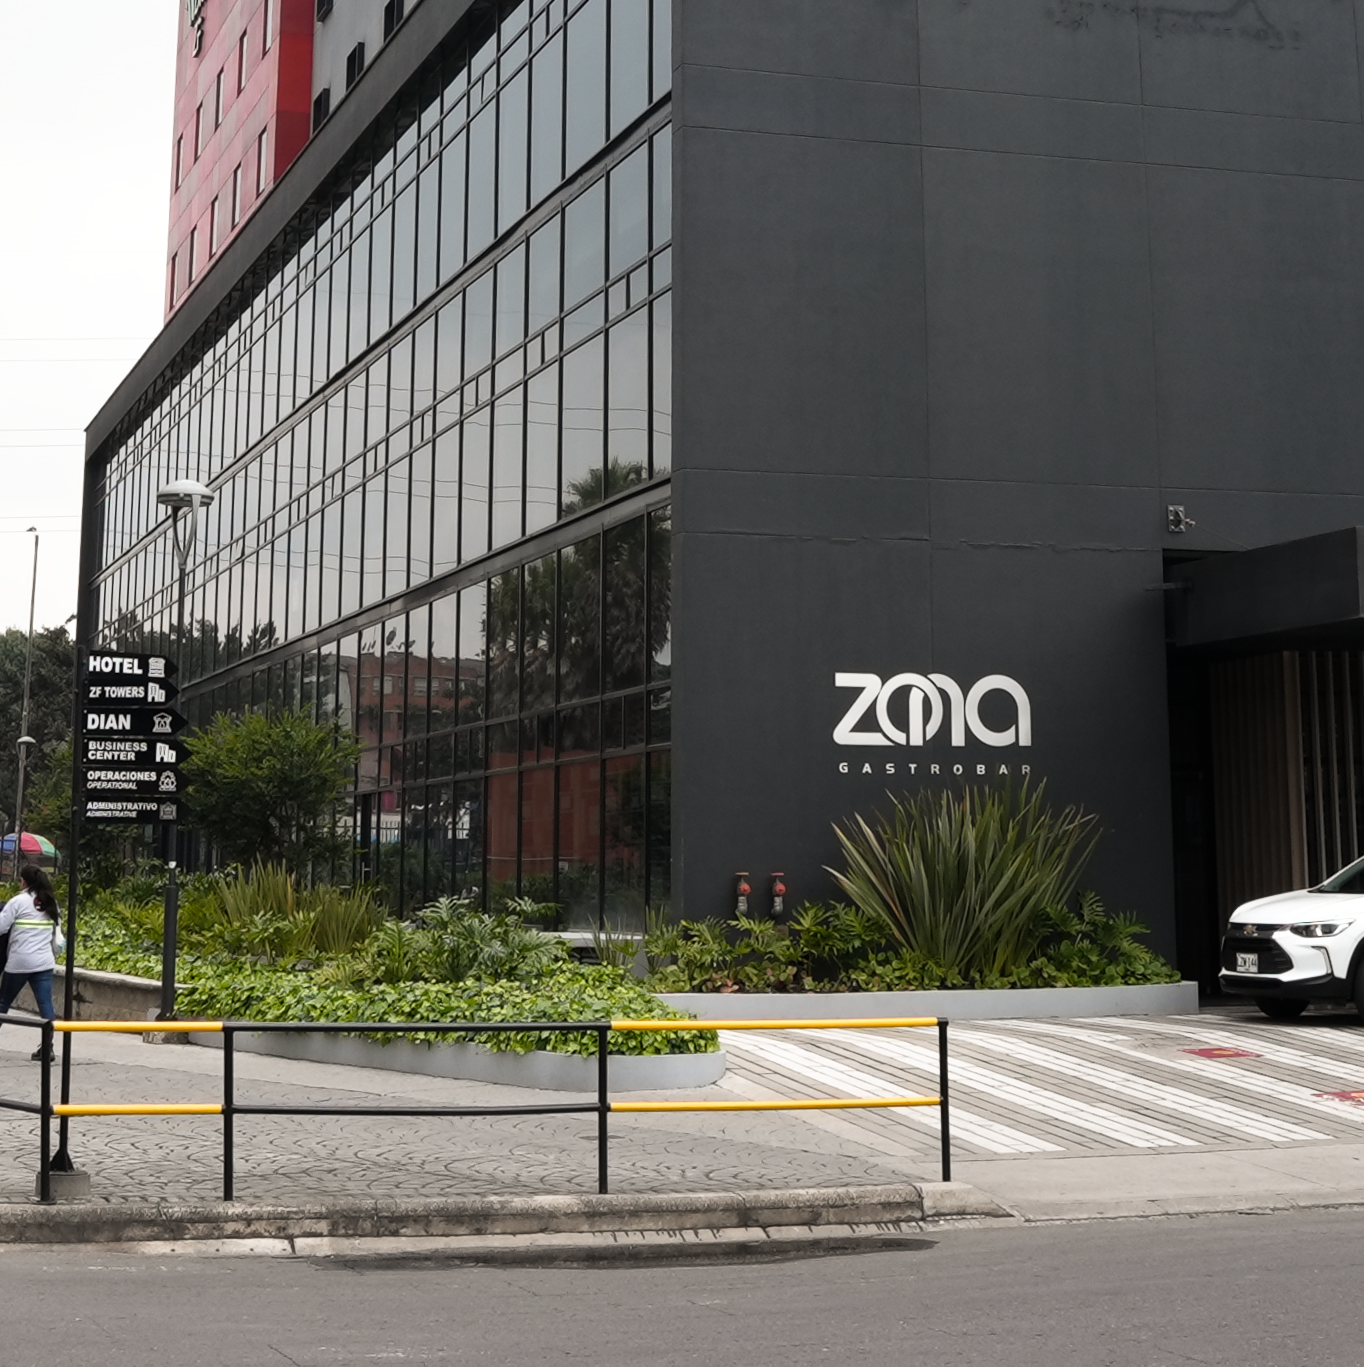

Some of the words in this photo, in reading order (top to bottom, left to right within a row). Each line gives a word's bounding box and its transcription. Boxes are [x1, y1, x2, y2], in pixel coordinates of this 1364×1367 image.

[89, 655, 143, 674] HOTEL
[89, 686, 102, 698] ZF
[104, 686, 145, 698] TOWERS
[87, 713, 131, 730] DIAN
[88, 740, 148, 752] BUSINESS
[88, 750, 136, 761] CENTER
[838, 762, 1031, 775] GASTROBAR
[87, 770, 157, 781] OPERACIONES
[86, 781, 137, 790] OPERATIONAL
[86, 801, 158, 811] ADMINISTRATIVO
